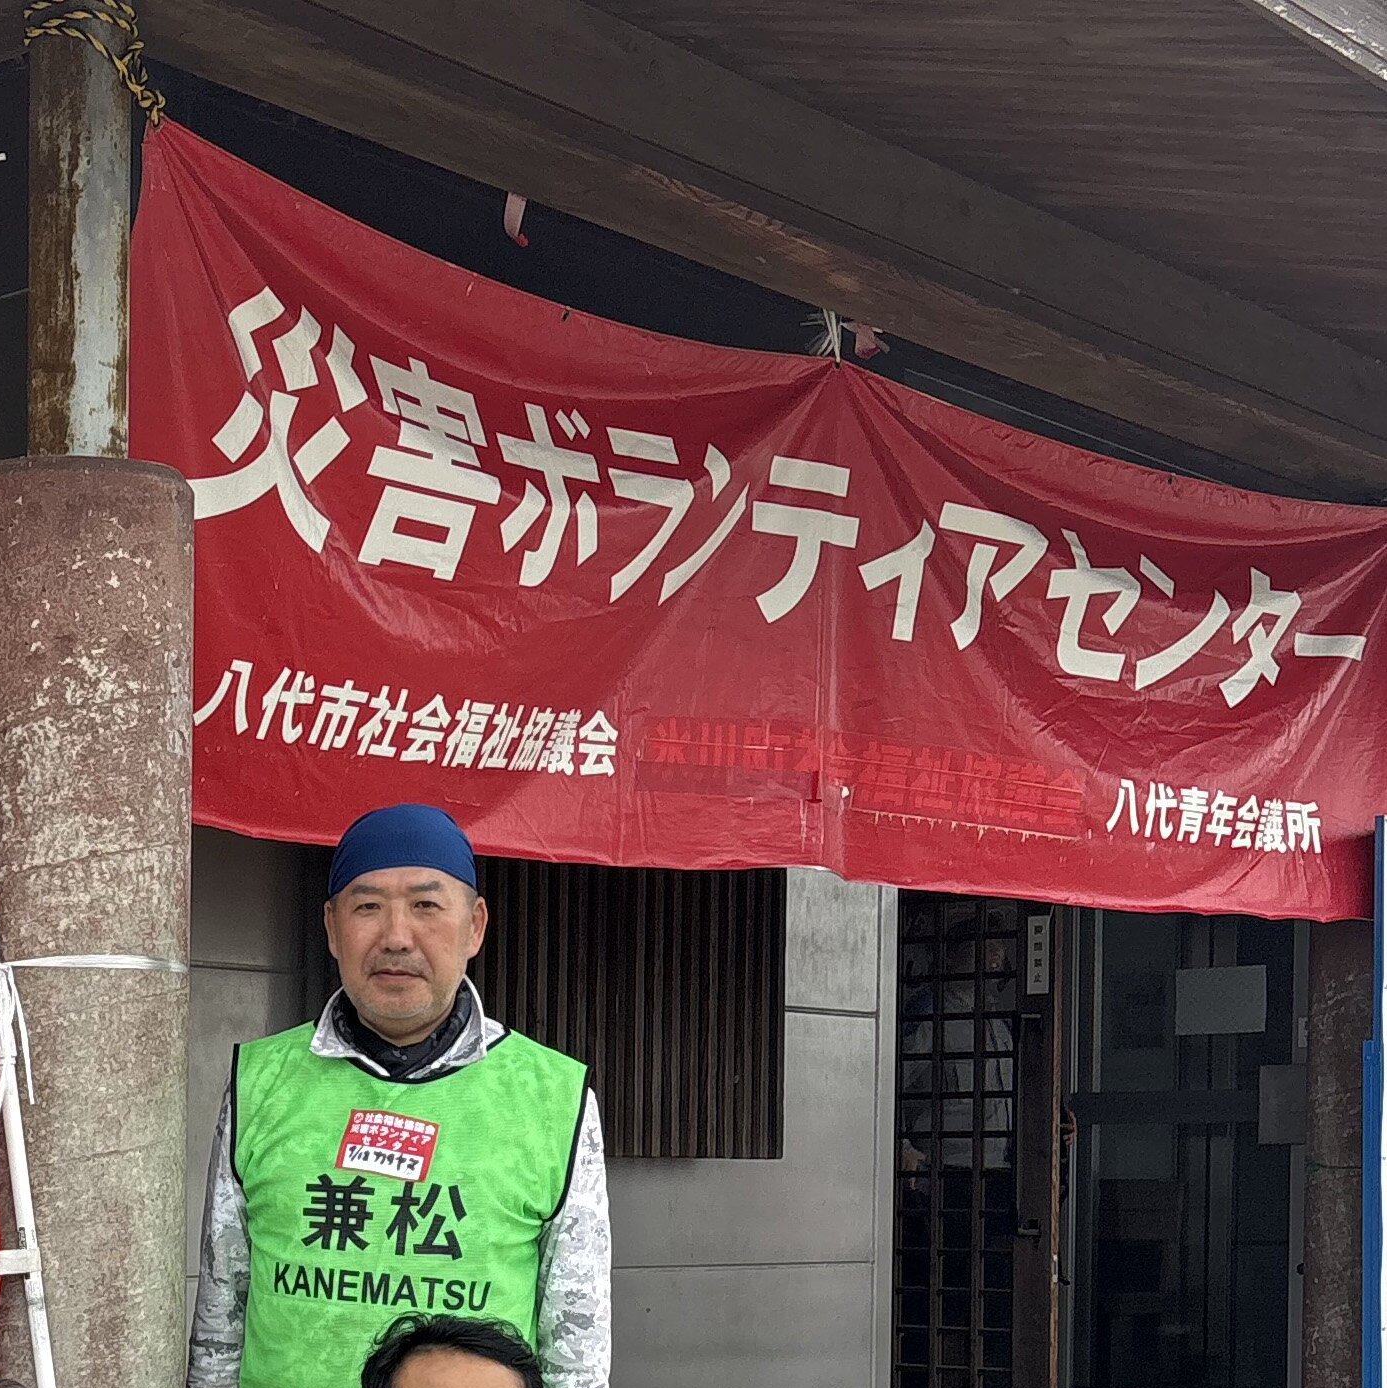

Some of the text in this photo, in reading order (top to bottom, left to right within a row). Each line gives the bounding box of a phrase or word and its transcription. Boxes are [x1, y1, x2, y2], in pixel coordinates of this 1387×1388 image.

[186, 284, 1369, 710] 災害ボランティアセンター
[193, 659, 620, 777] 八代市社会福祉協議会
[1106, 778, 1324, 855] 八代青年会議所
[301, 1173, 468, 1261] 兼松
[273, 1262, 491, 1312] KANEMATSU
